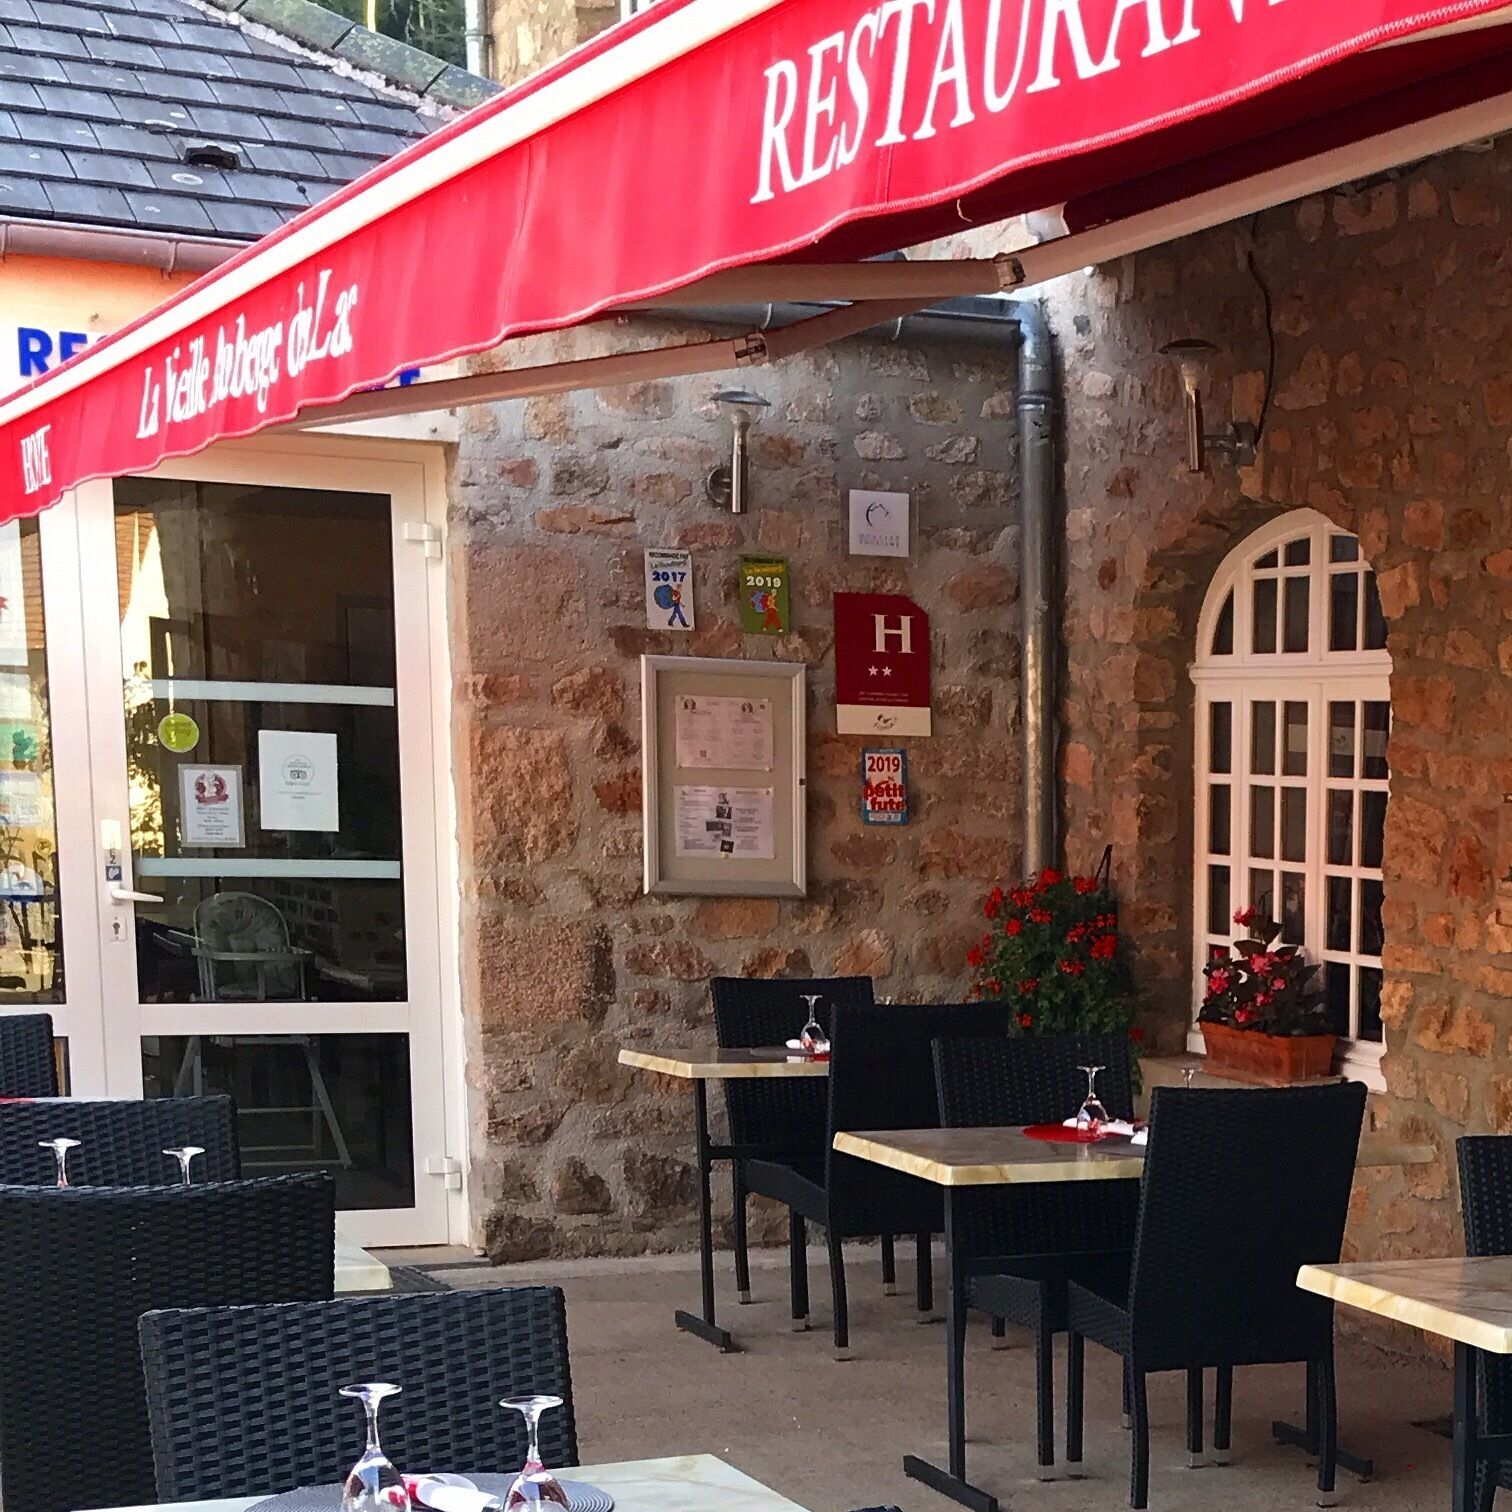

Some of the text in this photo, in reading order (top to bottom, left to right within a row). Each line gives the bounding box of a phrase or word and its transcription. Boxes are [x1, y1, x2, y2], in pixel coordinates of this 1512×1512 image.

[652, 570, 686, 582] 2017
[871, 613, 916, 654] H
[867, 756, 900, 773] 2019
